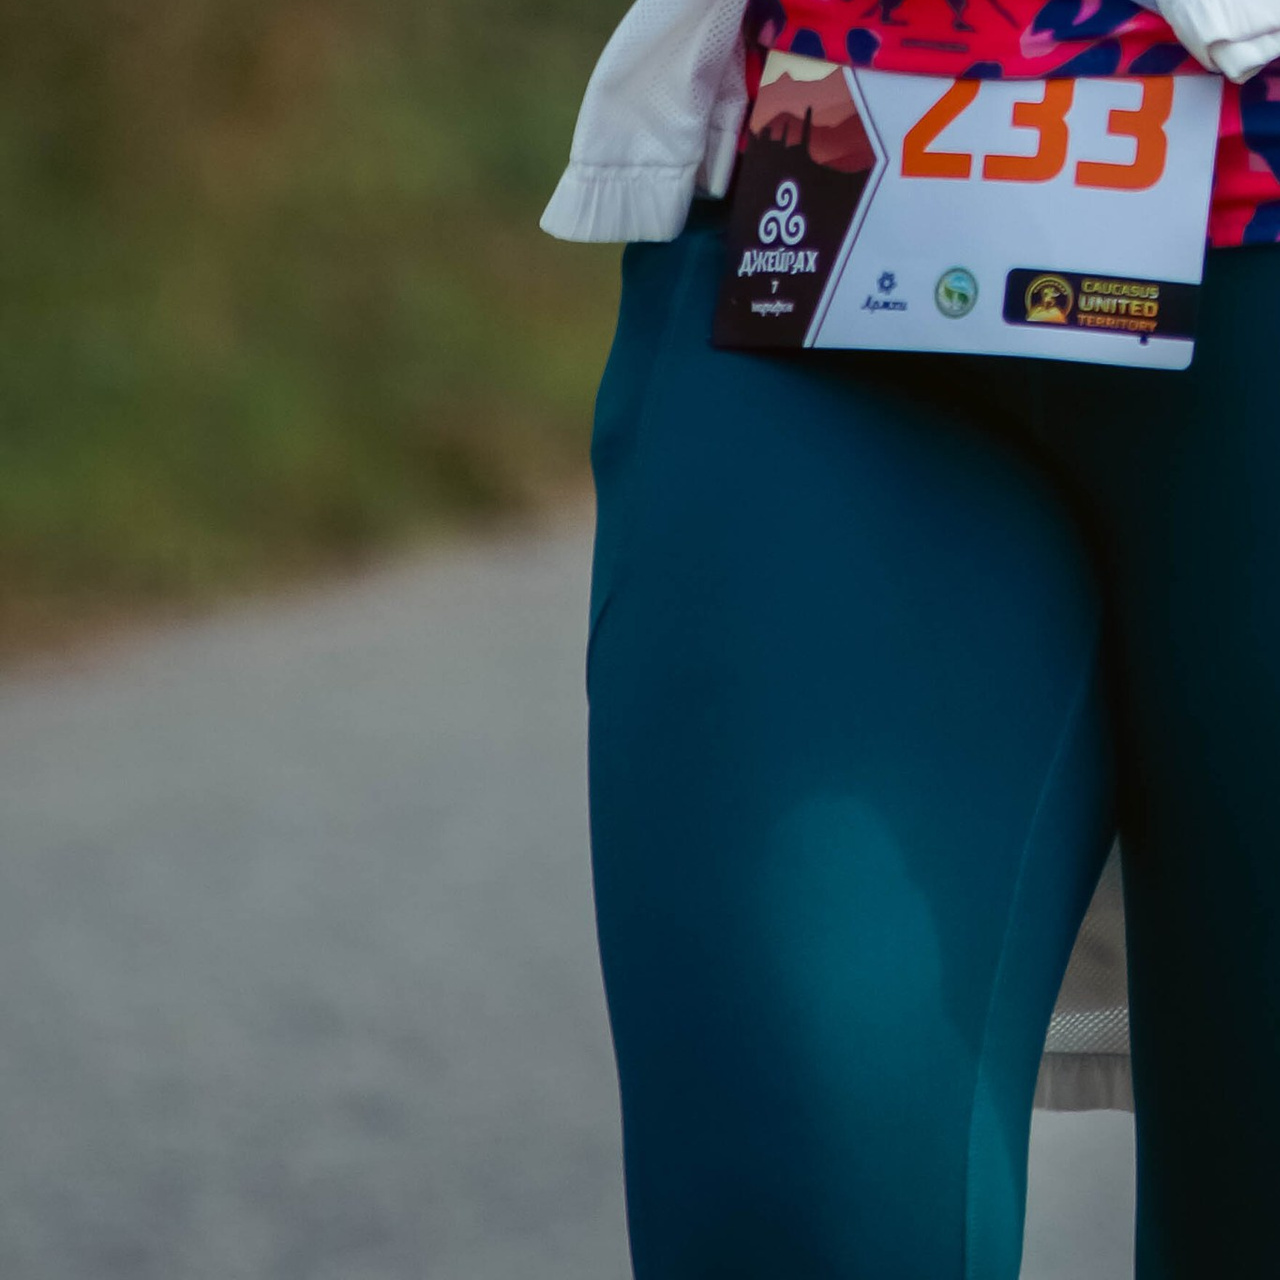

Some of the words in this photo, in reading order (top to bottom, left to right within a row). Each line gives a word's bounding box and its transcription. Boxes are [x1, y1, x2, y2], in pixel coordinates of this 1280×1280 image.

[901, 76, 1174, 191] 233
[738, 247, 819, 277] ДЖЕЙРАХ
[1081, 279, 1160, 299] CAUCASUS
[1078, 294, 1159, 317] UNITED
[1077, 314, 1158, 332] TERRITORY
